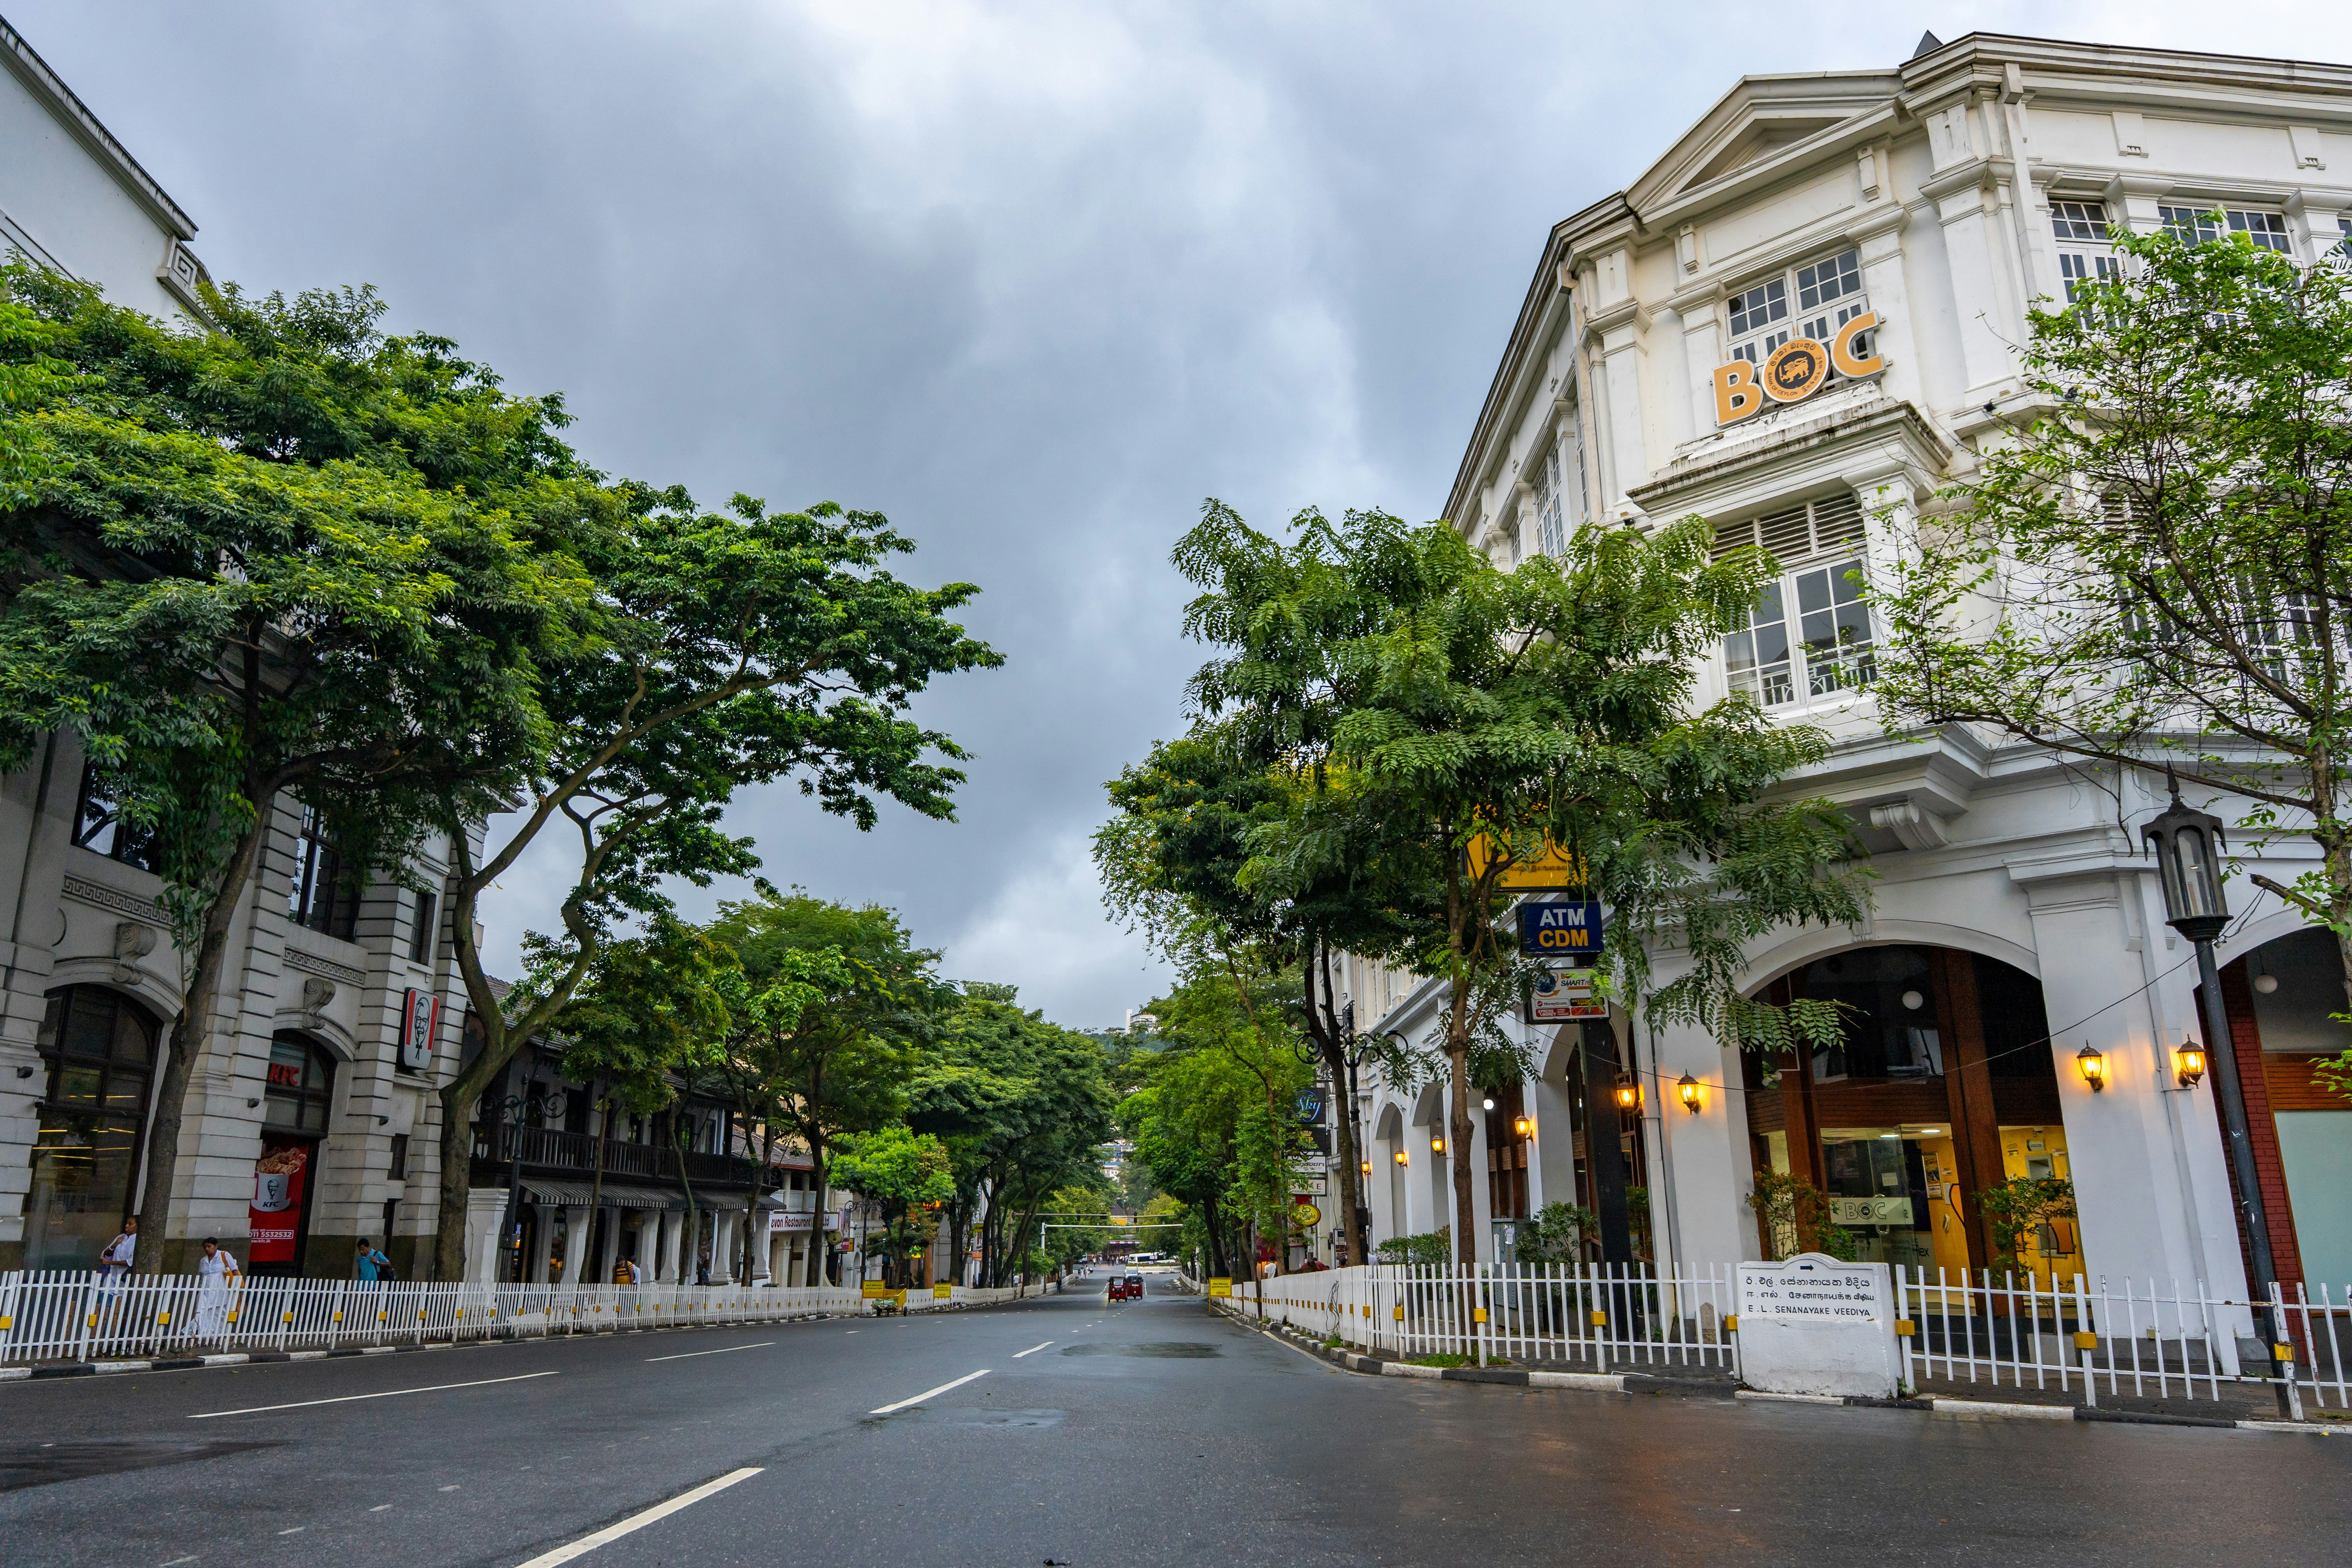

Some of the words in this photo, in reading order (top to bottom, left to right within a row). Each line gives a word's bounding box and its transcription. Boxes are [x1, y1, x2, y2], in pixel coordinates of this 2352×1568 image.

[1770, 348, 1787, 366] ලංකා
[1712, 309, 1886, 427] BOC
[1539, 908, 1585, 926] ATM
[1539, 929, 1588, 947] CDM
[269, 1063, 300, 1085] KFC
[1845, 1202, 1886, 1220] BOC
[771, 1218, 783, 1228] evon
[784, 1215, 811, 1227] Restaurant
[1775, 1305, 1830, 1314] SENANAYAKE
[1834, 1308, 1871, 1316] VEEDIYA
